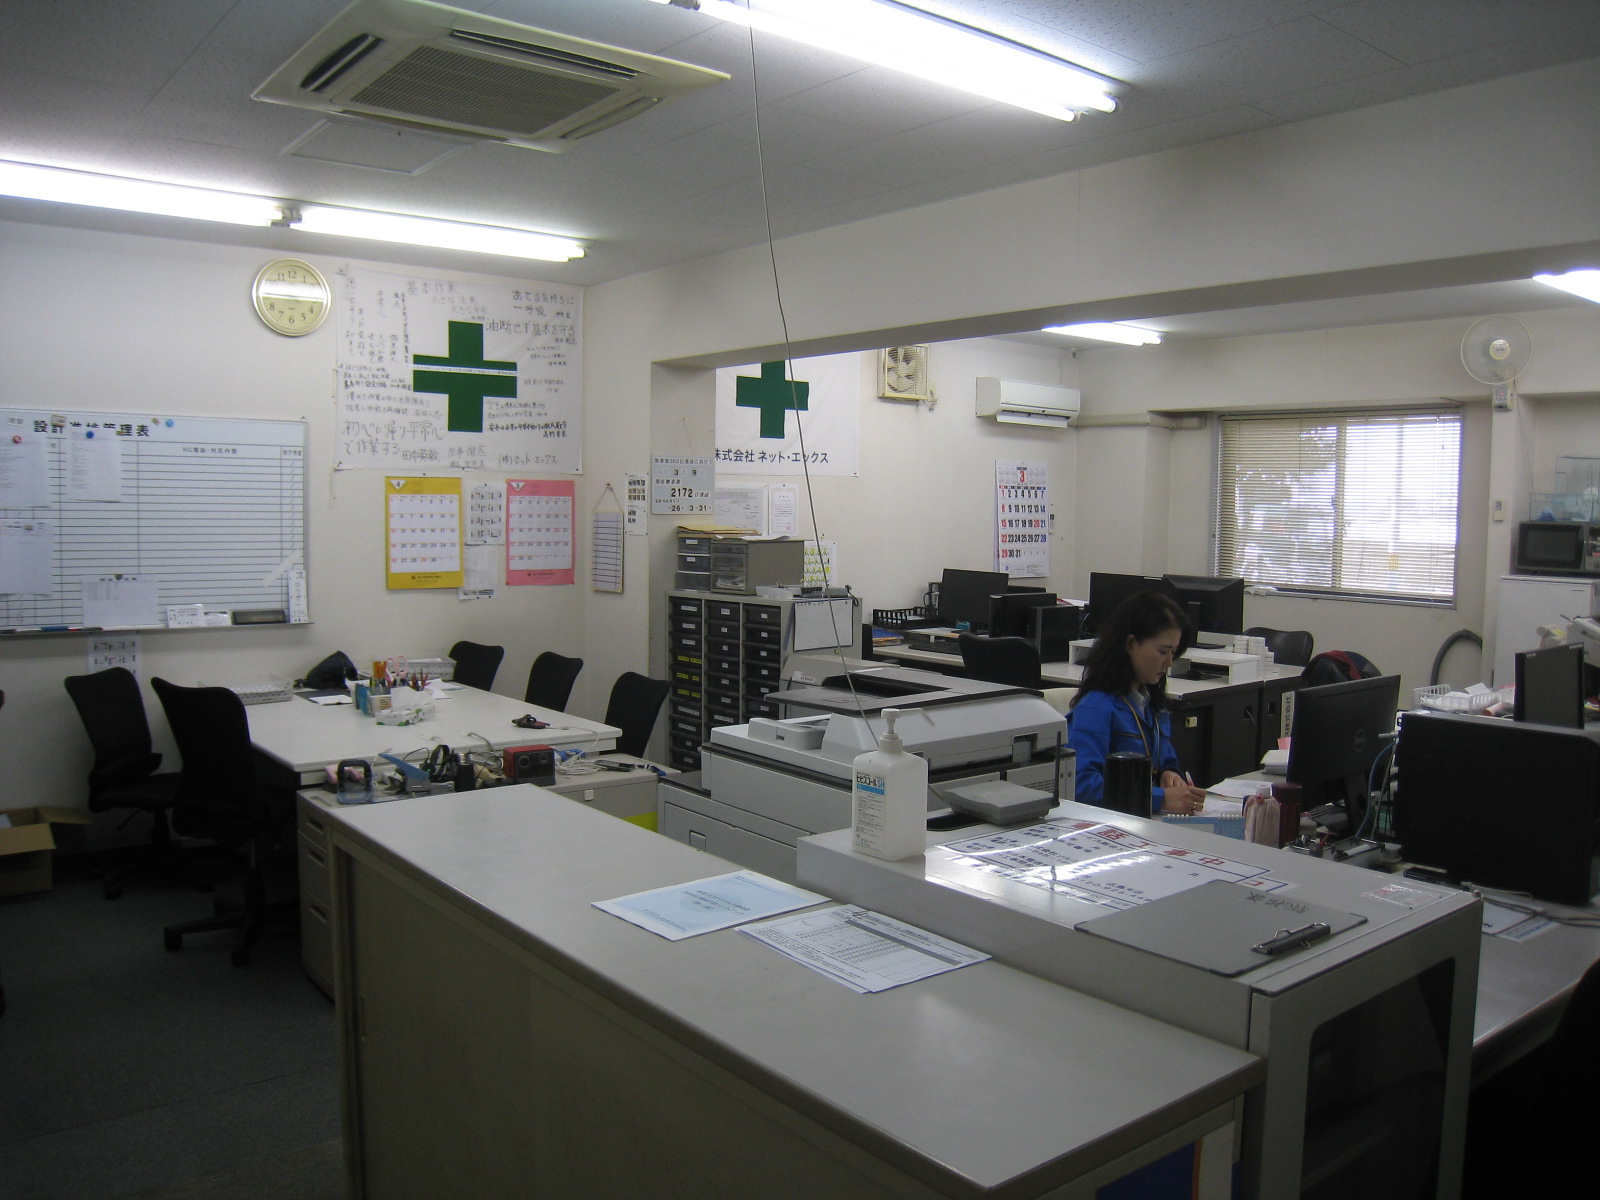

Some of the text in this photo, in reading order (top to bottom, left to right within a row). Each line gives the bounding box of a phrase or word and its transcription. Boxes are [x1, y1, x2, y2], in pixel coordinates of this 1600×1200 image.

[277, 273, 285, 281] 11
[287, 270, 297, 279] 12
[303, 275, 306, 283] 1
[270, 303, 275, 311] 8
[308, 306, 314, 314] 4
[278, 311, 284, 319] 7
[301, 313, 306, 321] 5
[289, 316, 295, 324] 6
[485, 319, 576, 337] 油断せず基本を守る
[1020, 470, 1025, 483] 3
[671, 488, 693, 498] 2172
[1001, 490, 1005, 498] 1
[1008, 490, 1012, 498] 2
[1014, 490, 1018, 498] 3
[1021, 490, 1025, 498] 4
[1027, 490, 1031, 498] 5
[1041, 491, 1044, 499] 7
[1008, 504, 1012, 512] 9
[1014, 504, 1020, 513] 10
[1021, 505, 1026, 513] 11
[1027, 505, 1033, 513] 12
[1034, 505, 1039, 513] 13
[1040, 505, 1045, 513] 14
[1001, 519, 1046, 528] 15 16 17 18 19 20 21
[1001, 534, 1047, 543] 22 23 24 25 26 27 28
[1001, 549, 1021, 558] 29 30 31
